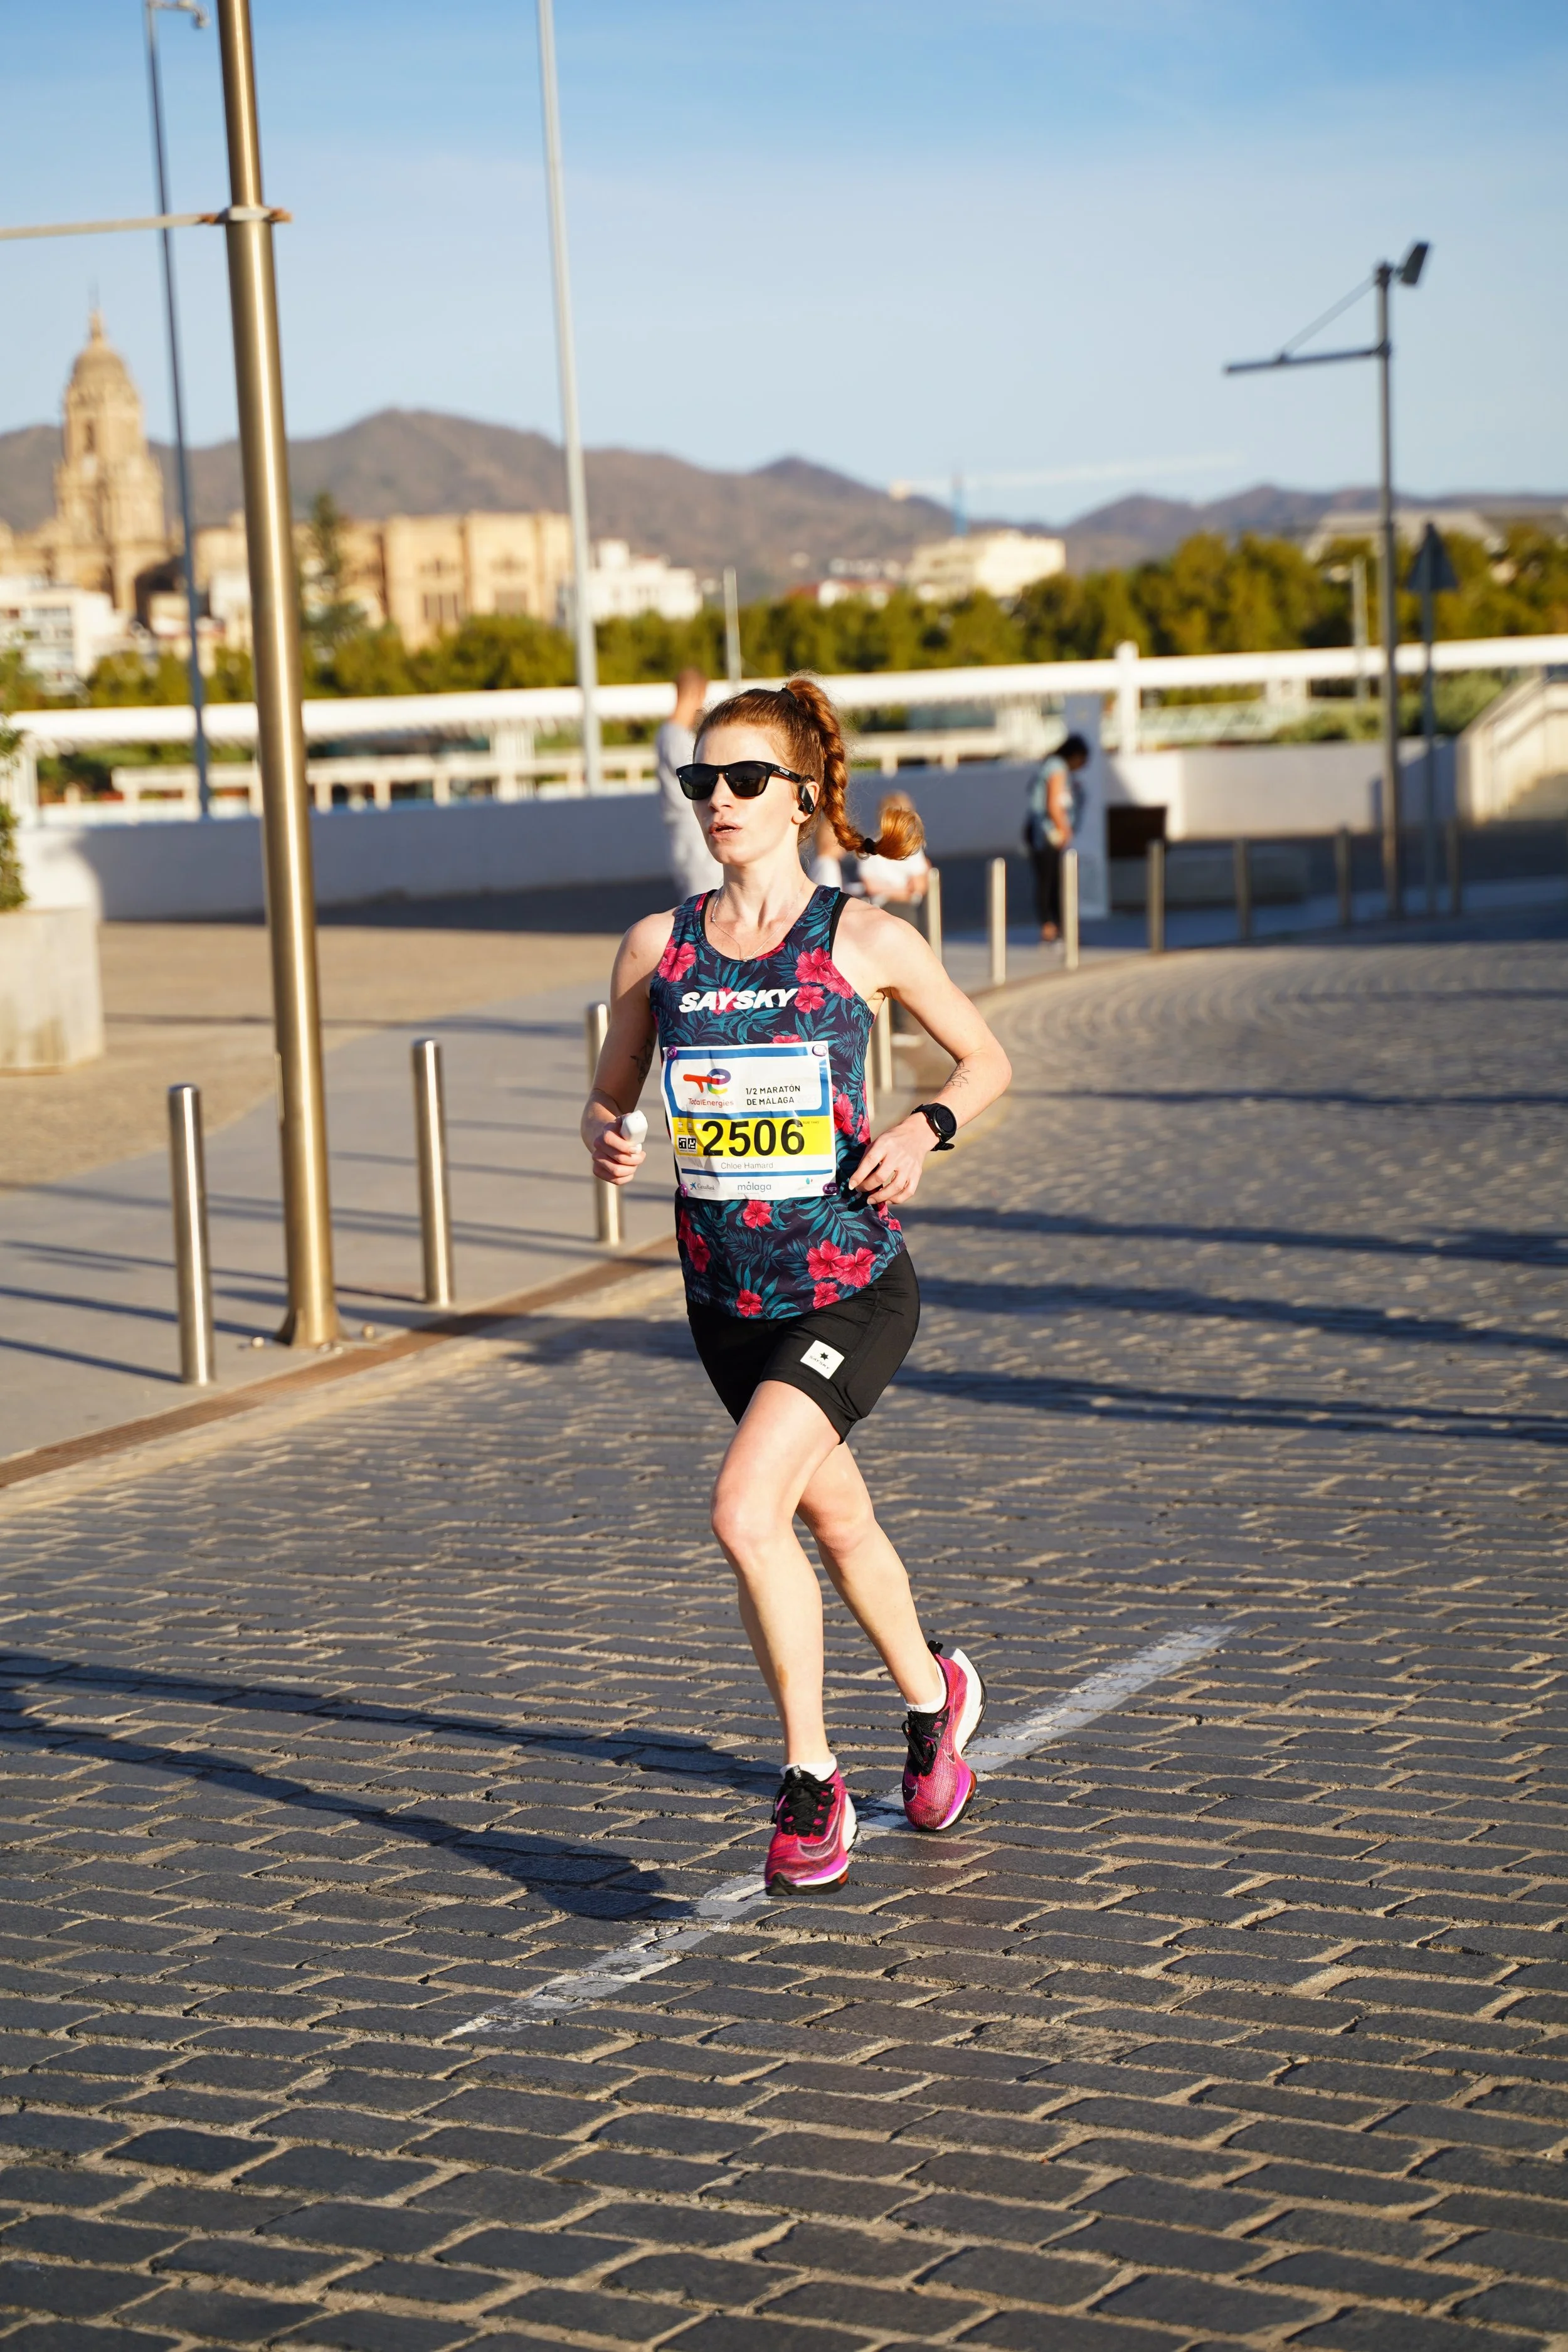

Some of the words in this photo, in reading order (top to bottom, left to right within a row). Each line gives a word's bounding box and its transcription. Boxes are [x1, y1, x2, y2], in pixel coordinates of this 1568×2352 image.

[679, 988, 798, 1014] SAYSKY
[760, 1084, 801, 1094] MARATÓN
[687, 1098, 734, 1108] TotalEnergies
[759, 1096, 795, 1105] MÁLAGA
[702, 1120, 805, 1157] 2506
